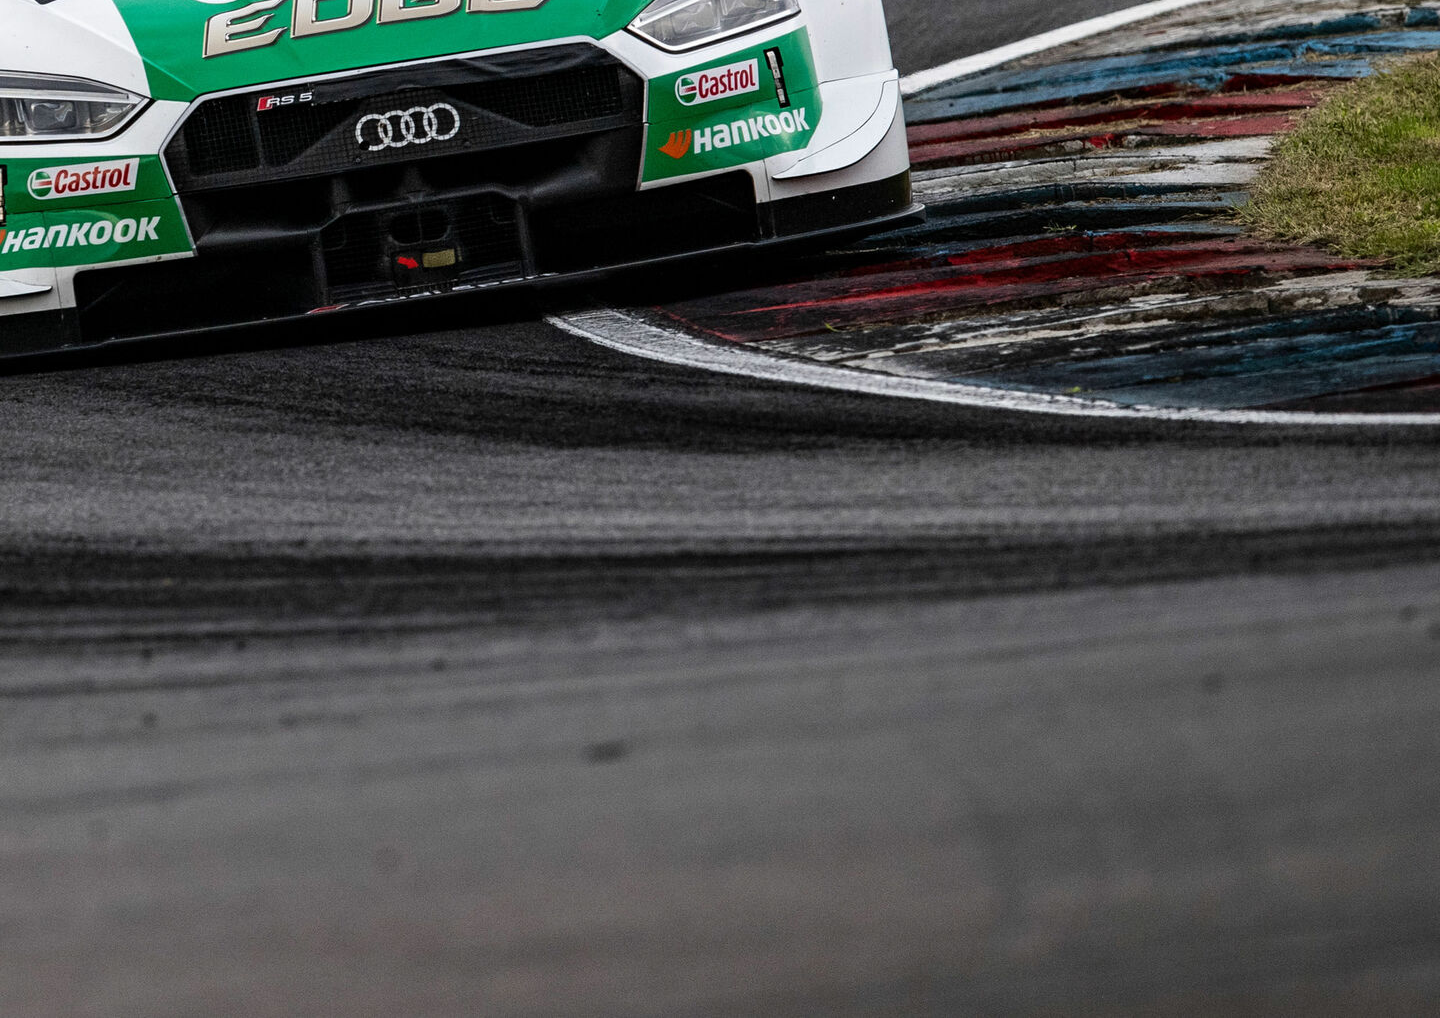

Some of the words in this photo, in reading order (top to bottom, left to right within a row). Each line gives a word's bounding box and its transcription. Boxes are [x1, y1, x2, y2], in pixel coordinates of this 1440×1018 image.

[698, 64, 756, 99] Castrol
[266, 95, 295, 108] RS
[299, 92, 313, 102] 5
[54, 163, 131, 194] Castrol
